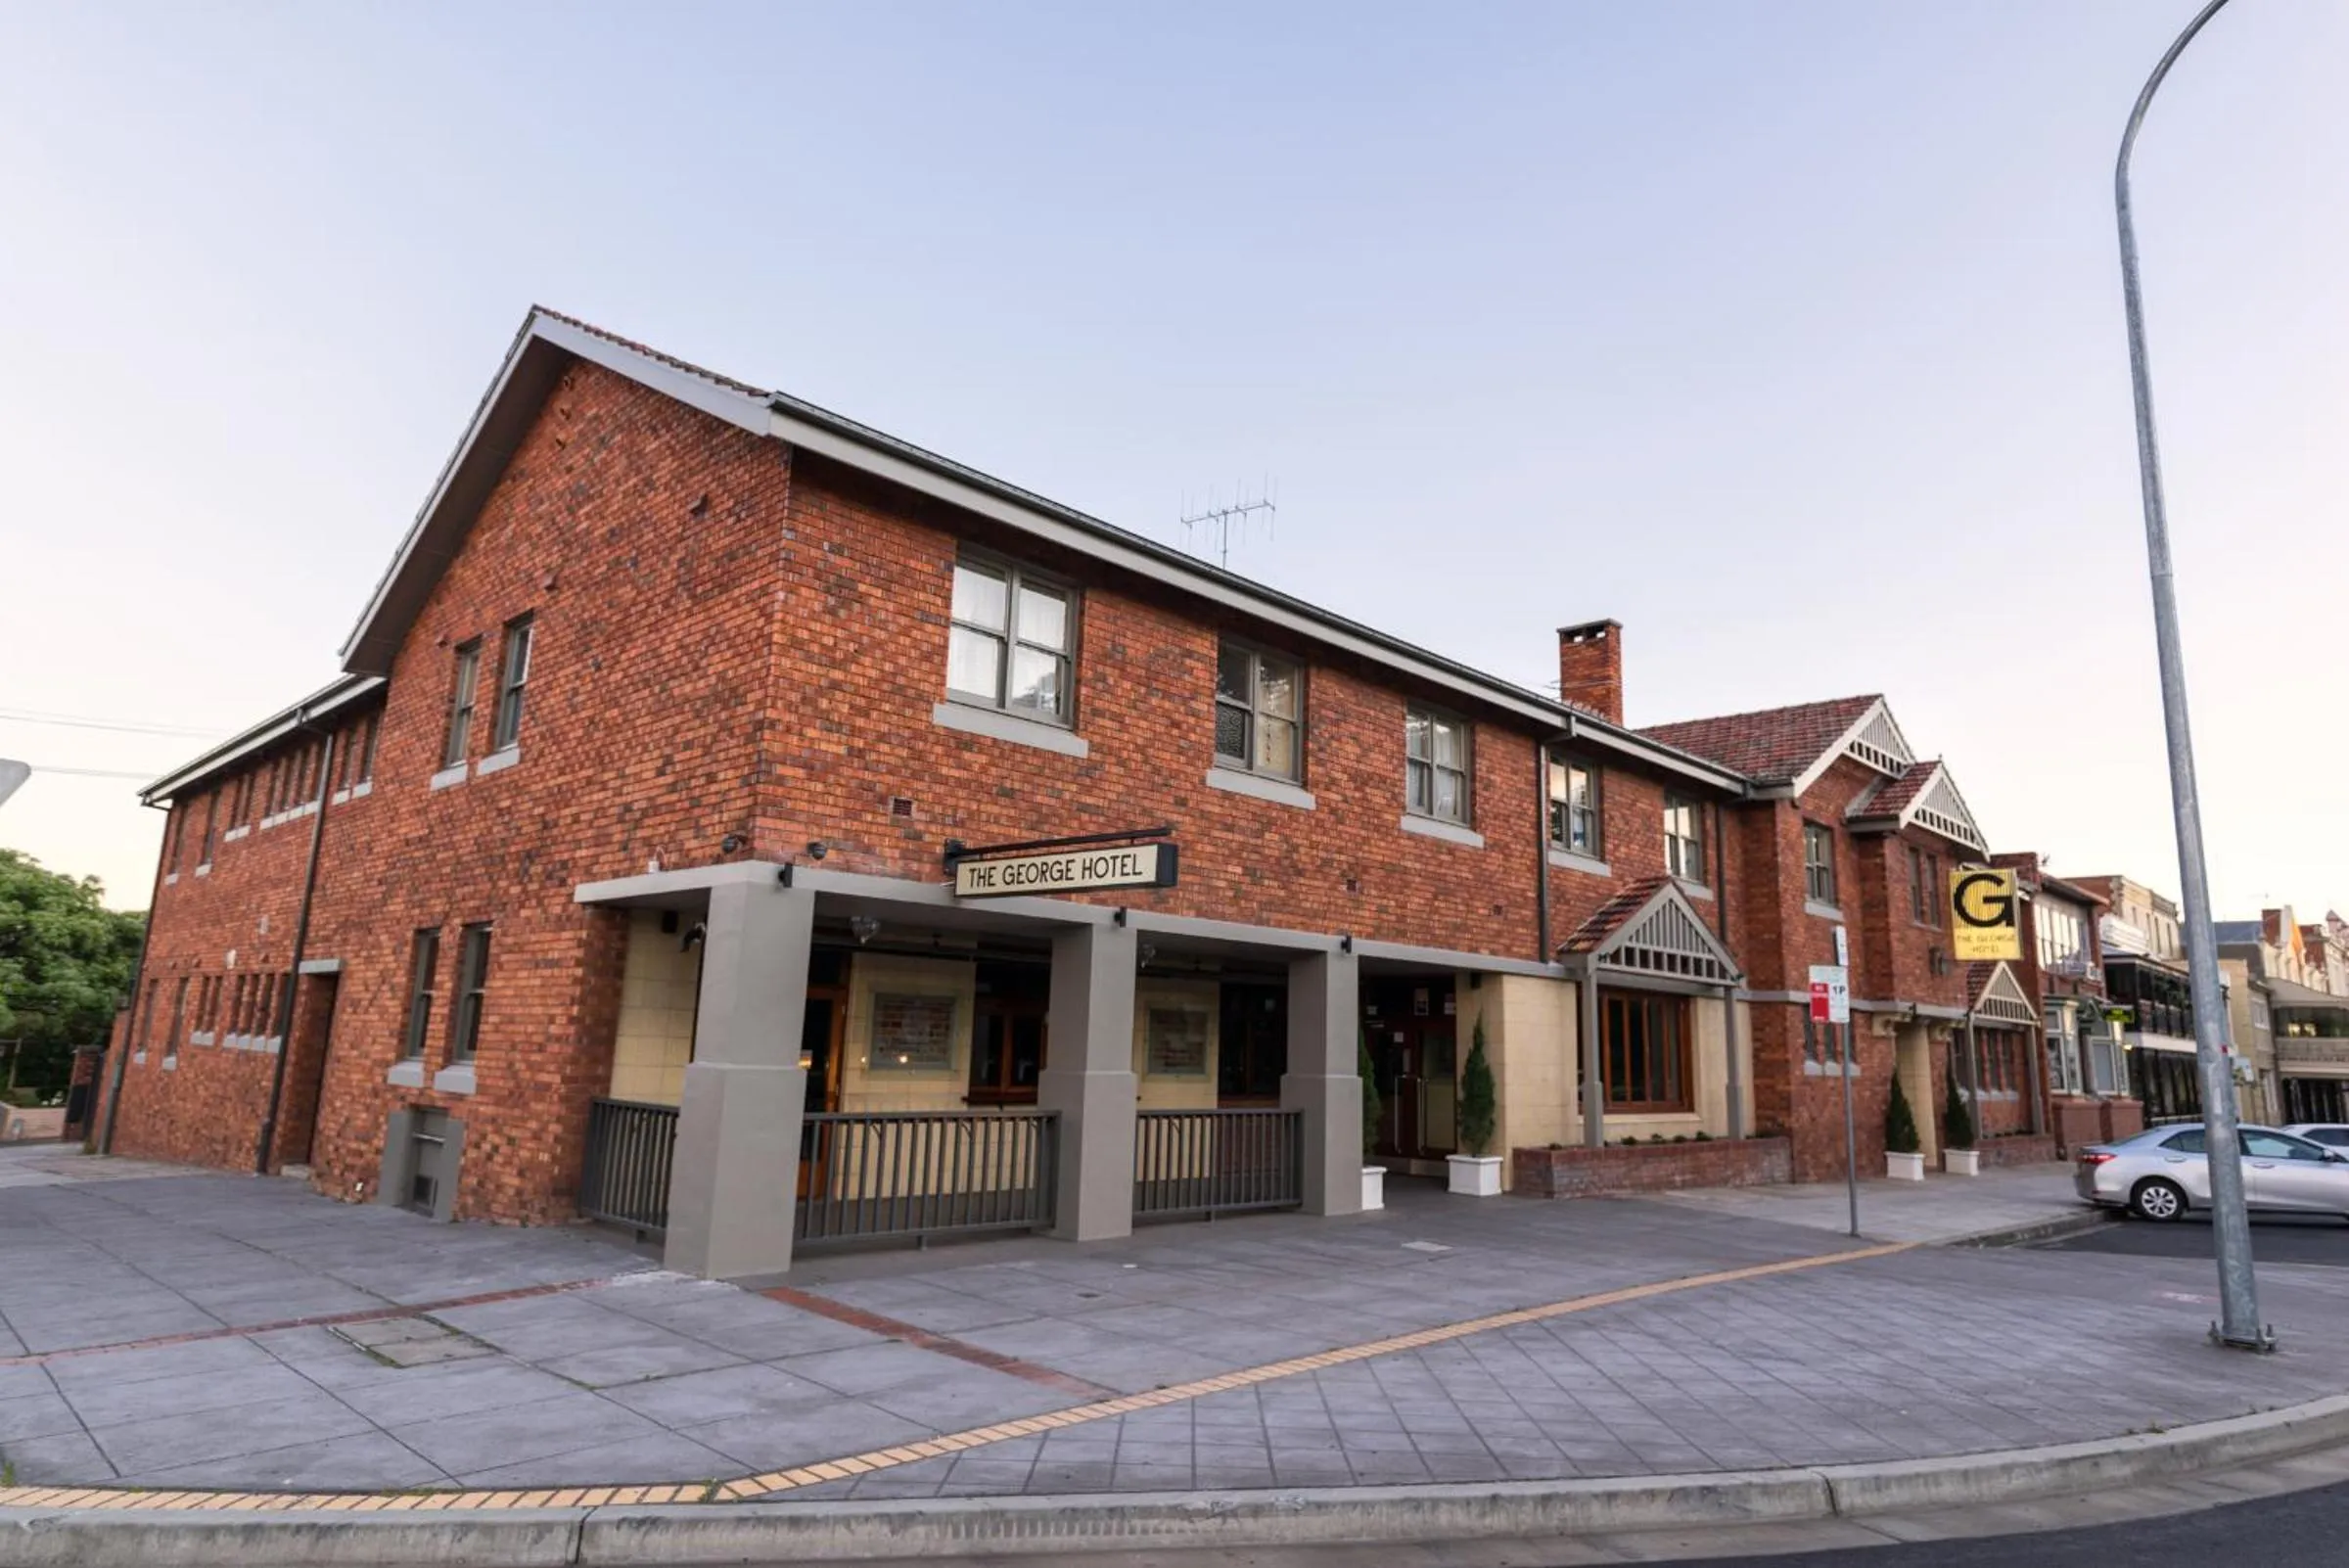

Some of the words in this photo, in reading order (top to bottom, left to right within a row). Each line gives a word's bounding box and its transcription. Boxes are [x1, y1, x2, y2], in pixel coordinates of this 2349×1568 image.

[969, 867, 996, 888] THE
[1002, 859, 1076, 886] GEORGE
[1082, 853, 1143, 880] HOTEL
[1954, 874, 2015, 928] G
